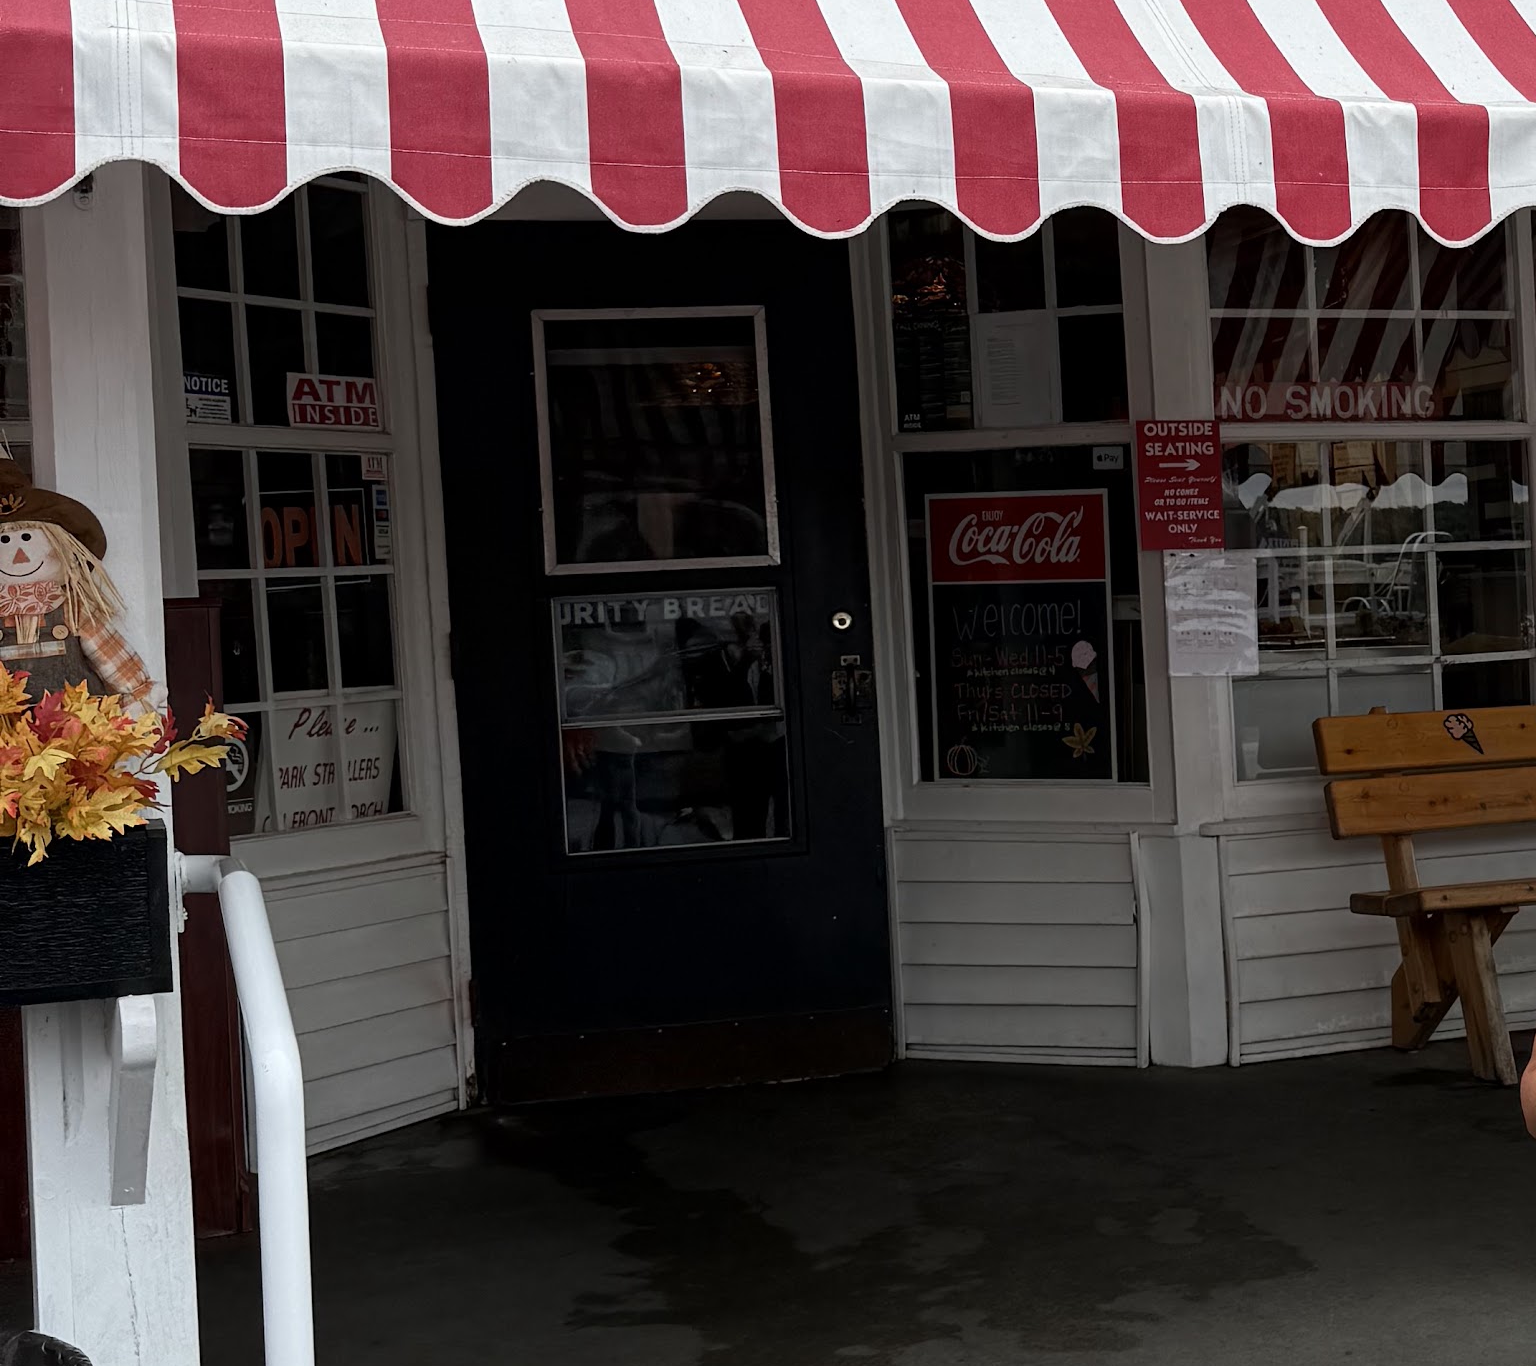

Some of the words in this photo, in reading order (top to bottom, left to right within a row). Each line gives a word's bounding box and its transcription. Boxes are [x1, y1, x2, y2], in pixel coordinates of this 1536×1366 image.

[184, 375, 229, 394] NOTICE
[291, 378, 376, 405] ATM
[1220, 387, 1267, 420] NO
[1285, 385, 1436, 419] SMOKING
[294, 405, 379, 426] INSIDE
[1143, 422, 1213, 437] OUTSIDE
[1145, 441, 1214, 456] SEATING
[1104, 453, 1119, 463] Pay
[1164, 488, 1175, 497] NO
[1175, 488, 1199, 496] CONES
[1154, 498, 1164, 506] OR
[1166, 498, 1175, 506] TO
[1176, 498, 1186, 506] GO
[1187, 497, 1209, 505] ITEMS
[982, 510, 1004, 522] ENJOY
[1145, 510, 1220, 521] WAIT-SERVICE
[949, 505, 1083, 566] Coca-Cola
[1168, 523, 1198, 534] ONLY
[1188, 535, 1207, 543] Thank
[1210, 535, 1222, 544] You
[561, 600, 650, 625] URITY
[952, 599, 1081, 641] Welcome!
[1011, 683, 1072, 699] CLOSED
[289, 708, 357, 739] Pleae
[313, 757, 380, 786] STRLLERS
[228, 802, 253, 814] OKING
